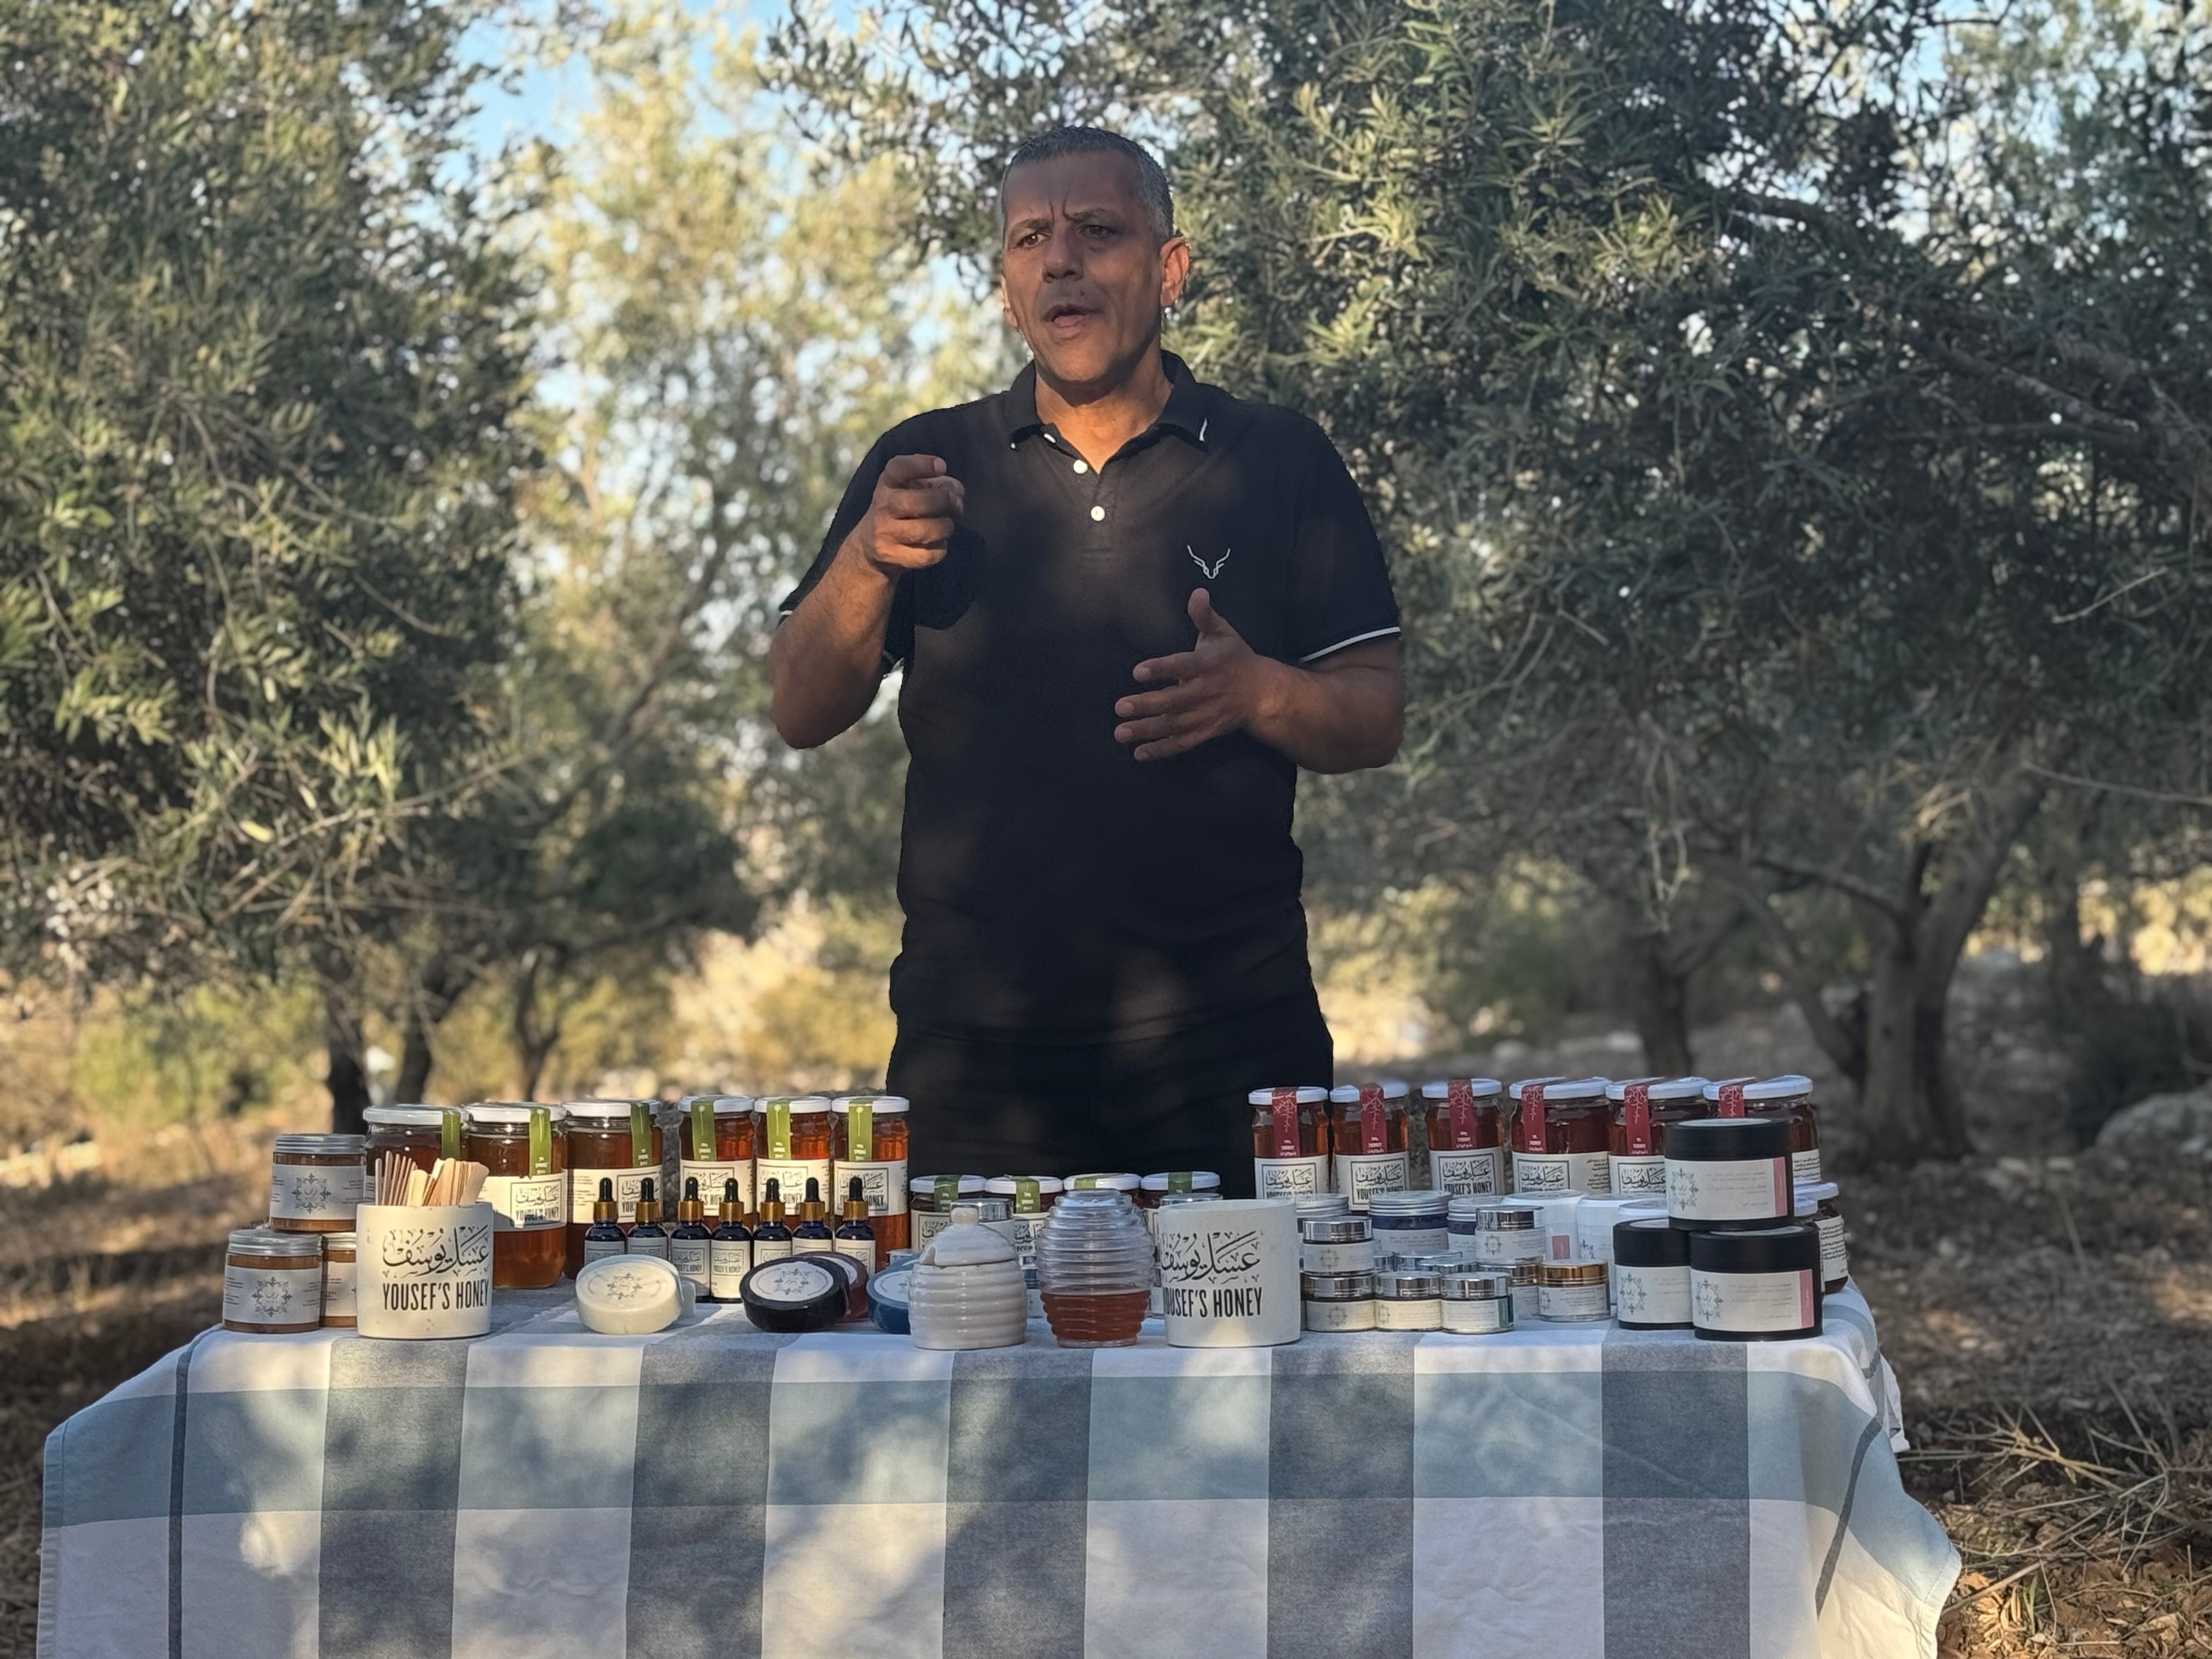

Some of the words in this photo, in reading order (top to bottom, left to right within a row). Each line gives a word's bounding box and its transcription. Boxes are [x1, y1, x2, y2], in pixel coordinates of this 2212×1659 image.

[1472, 1181, 1492, 1194] HONEY
[436, 1224, 489, 1274] عسل
[383, 1282, 450, 1311] YOUSEF'S
[455, 1279, 489, 1310] HONEY
[1213, 1287, 1262, 1318] HONEY
